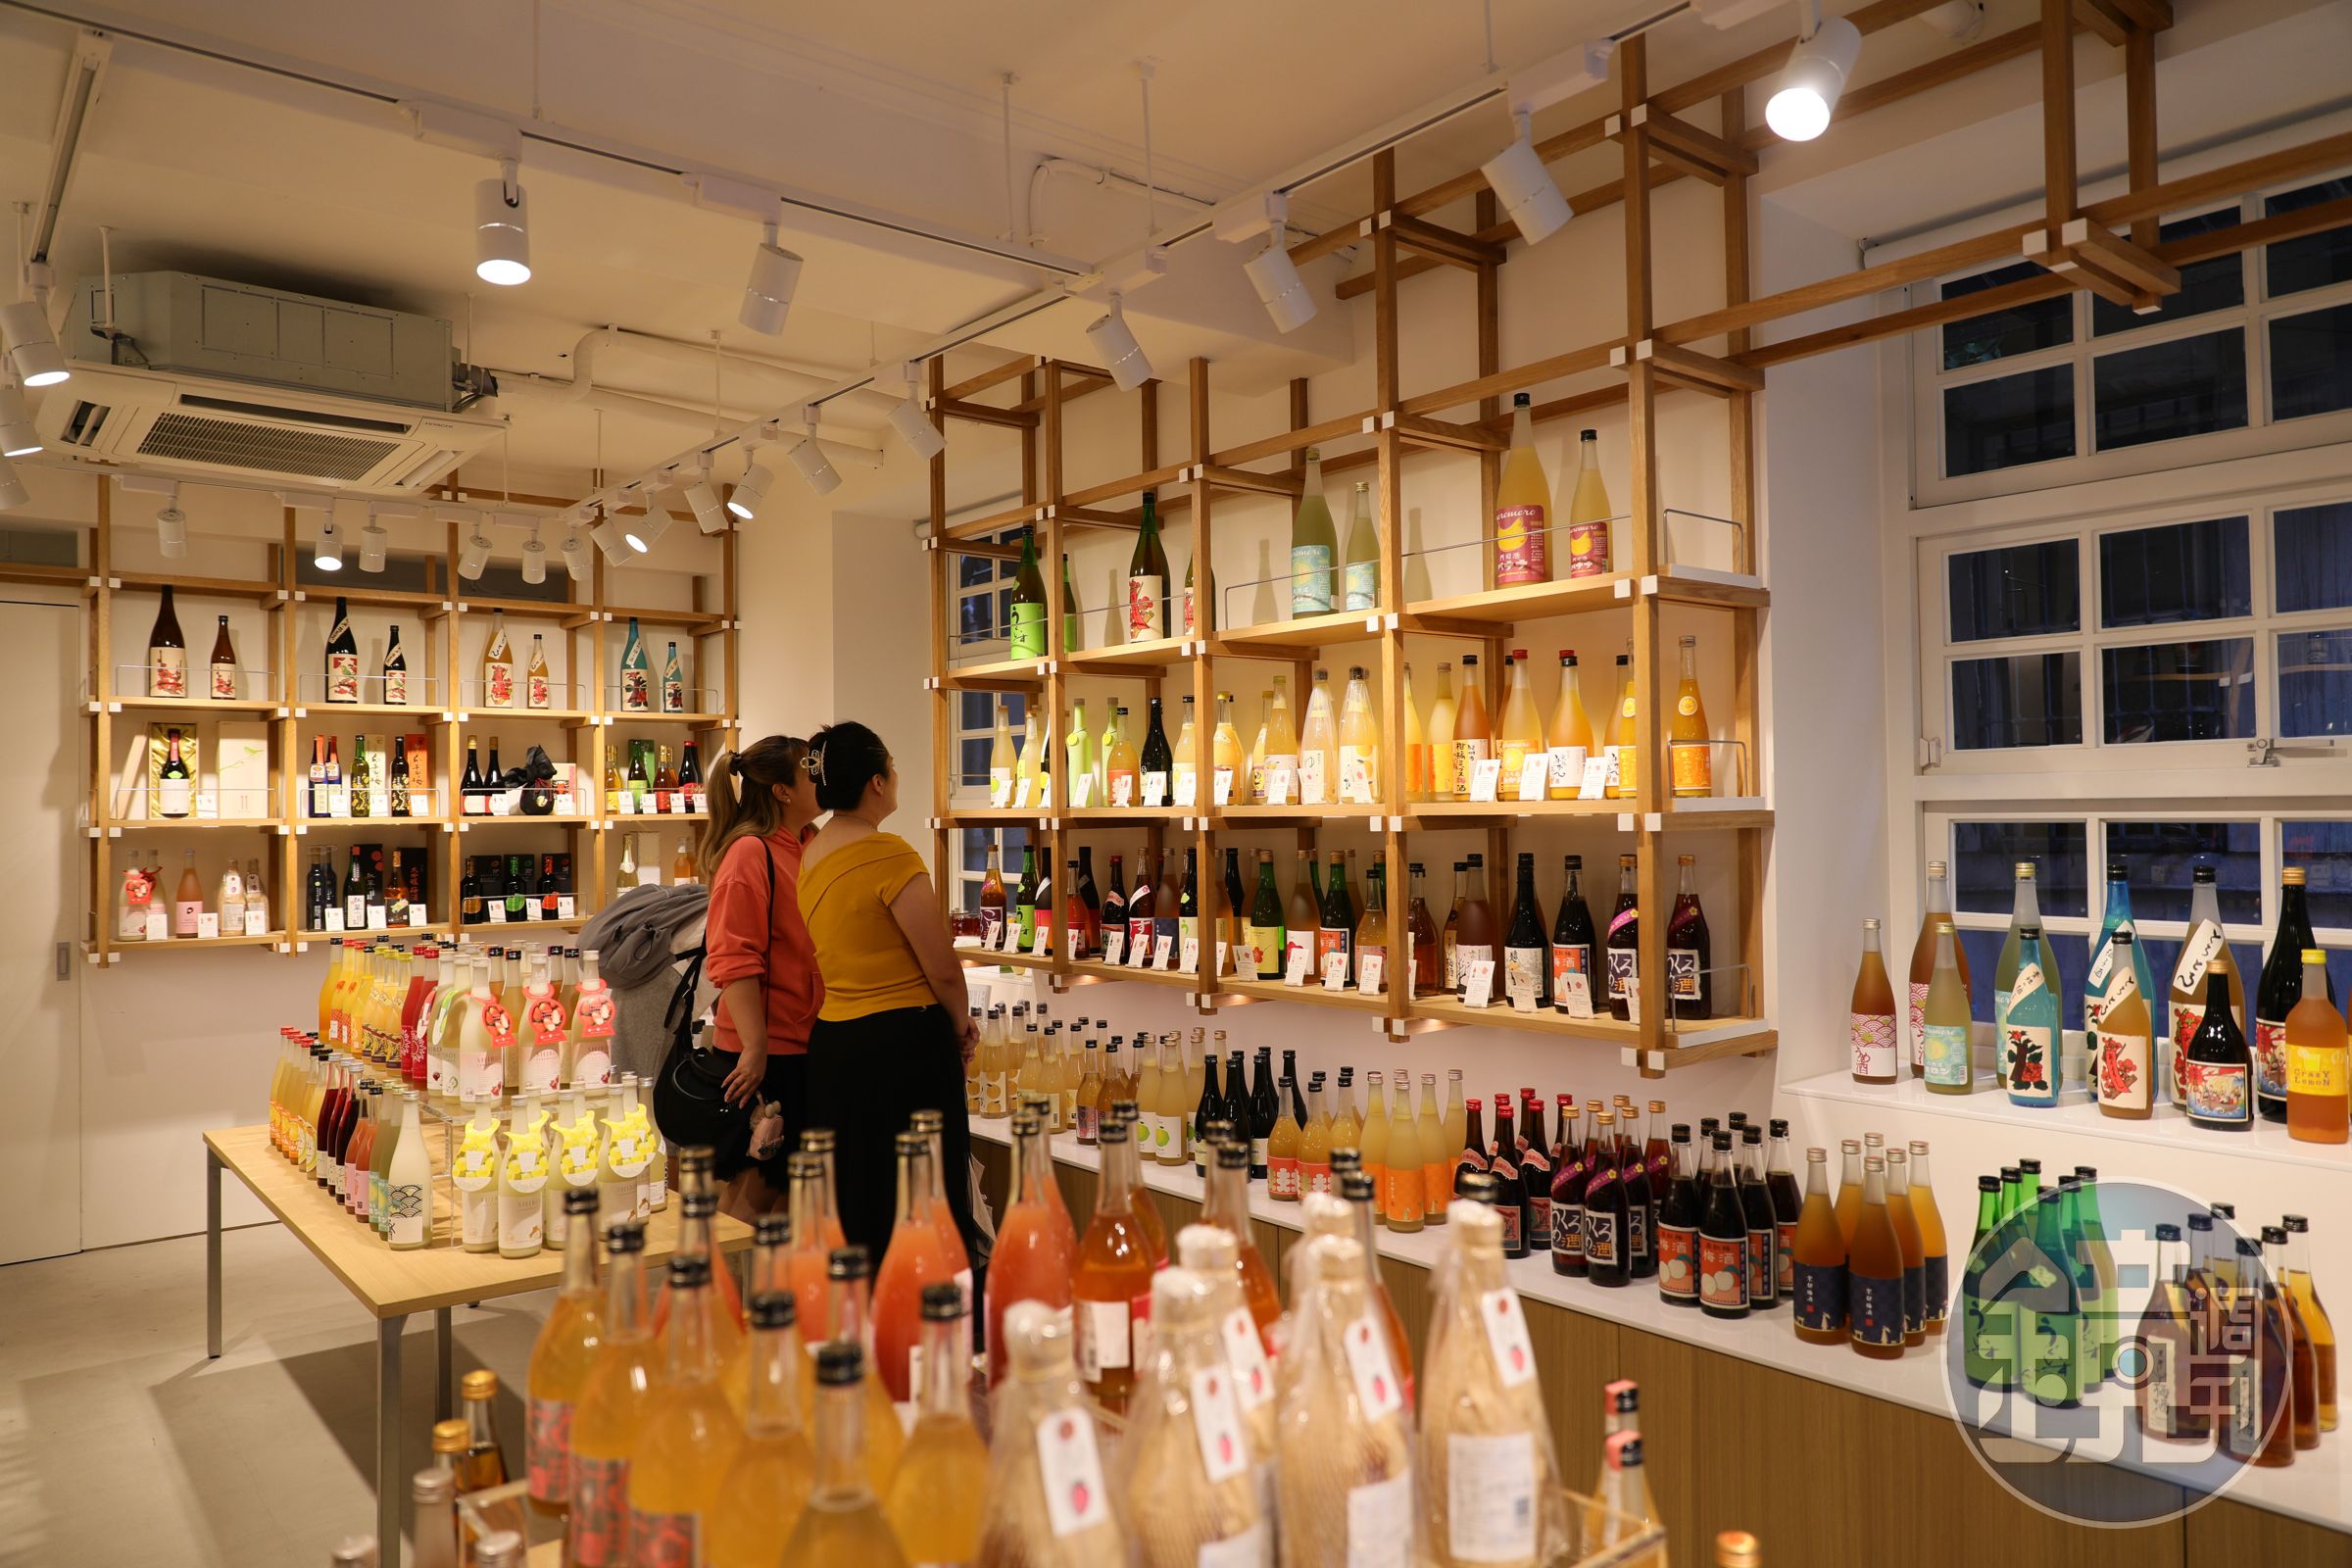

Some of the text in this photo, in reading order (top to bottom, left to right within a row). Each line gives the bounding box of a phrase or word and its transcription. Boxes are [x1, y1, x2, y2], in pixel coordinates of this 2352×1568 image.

[1561, 1233, 1581, 1249] 酒
[1592, 1242, 1612, 1257] 酒
[1703, 1250, 1735, 1264] 梅酒
